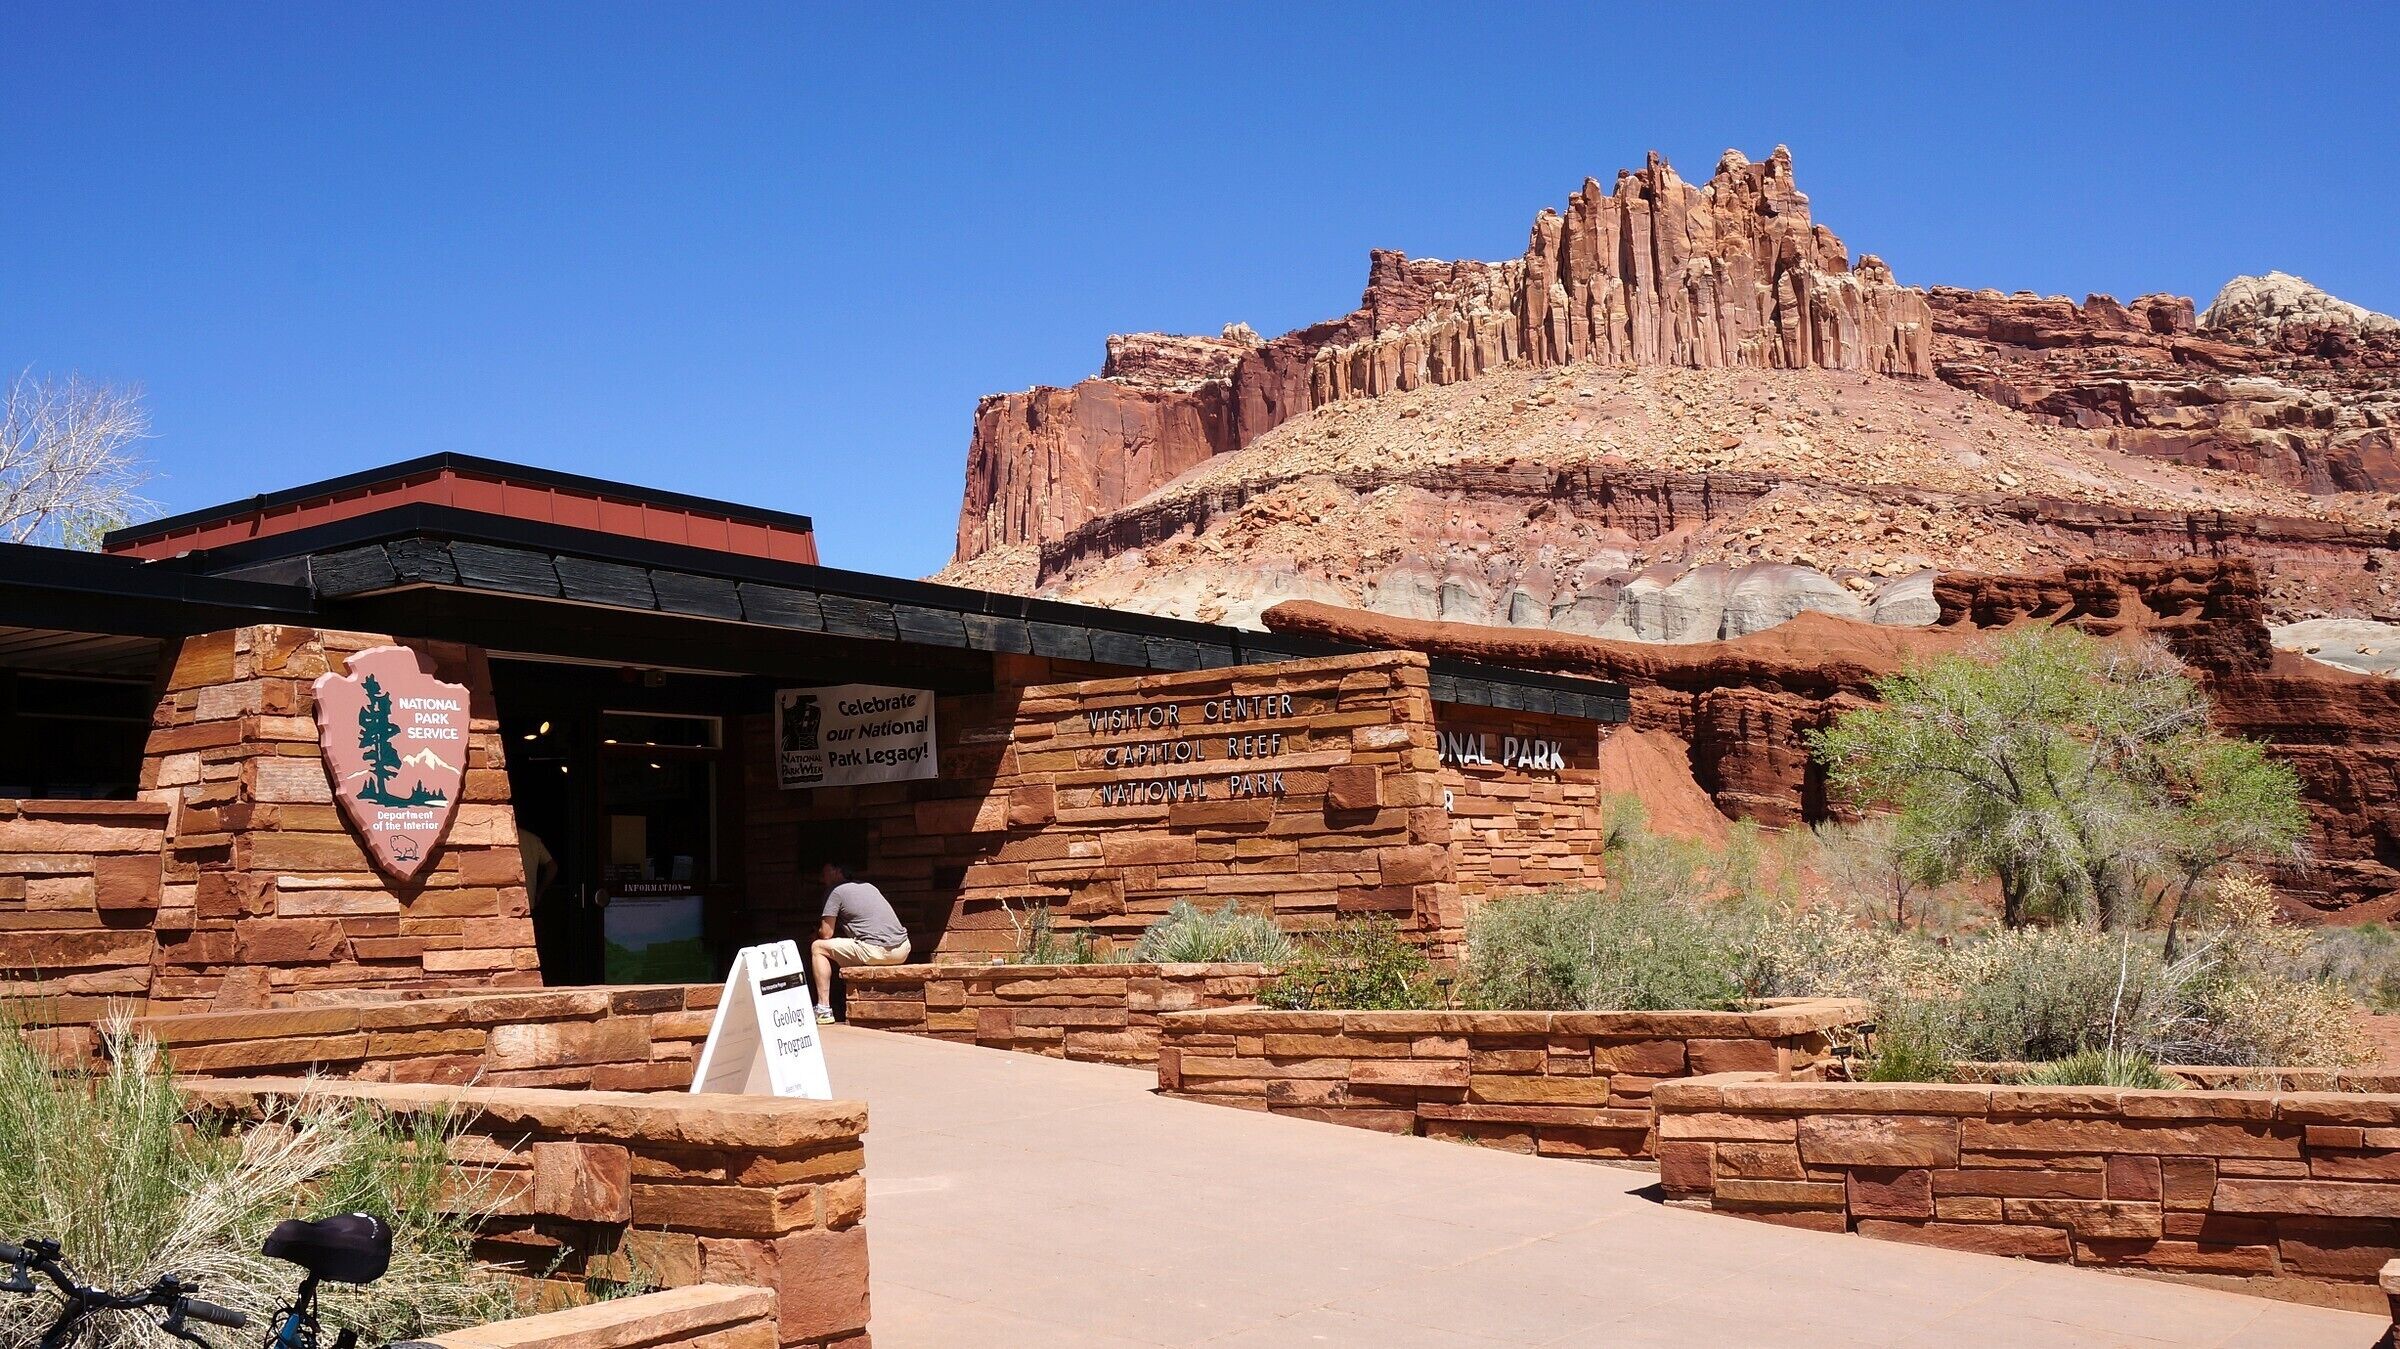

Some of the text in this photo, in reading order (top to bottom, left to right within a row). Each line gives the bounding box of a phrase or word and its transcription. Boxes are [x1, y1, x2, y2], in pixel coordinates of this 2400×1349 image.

[399, 698, 461, 711] NATIONAL
[838, 693, 917, 717] Celebrate
[1089, 694, 1293, 730] VISITOR CENTER
[415, 713, 449, 725] PARK
[826, 715, 929, 742] our National
[407, 727, 459, 740] SERVICE
[781, 752, 823, 765] NATIONAL
[828, 742, 929, 768] Park Legacy!
[1104, 733, 1281, 766] CAPITOL REEF
[1503, 736, 1565, 770] PARK
[1102, 772, 1286, 804] NATIONAL PARK
[372, 820, 439, 832] of the Interior
[377, 810, 433, 822] Department
[624, 883, 683, 892] INFORMATION
[773, 1006, 805, 1027] Geology
[777, 1034, 812, 1057] Program
